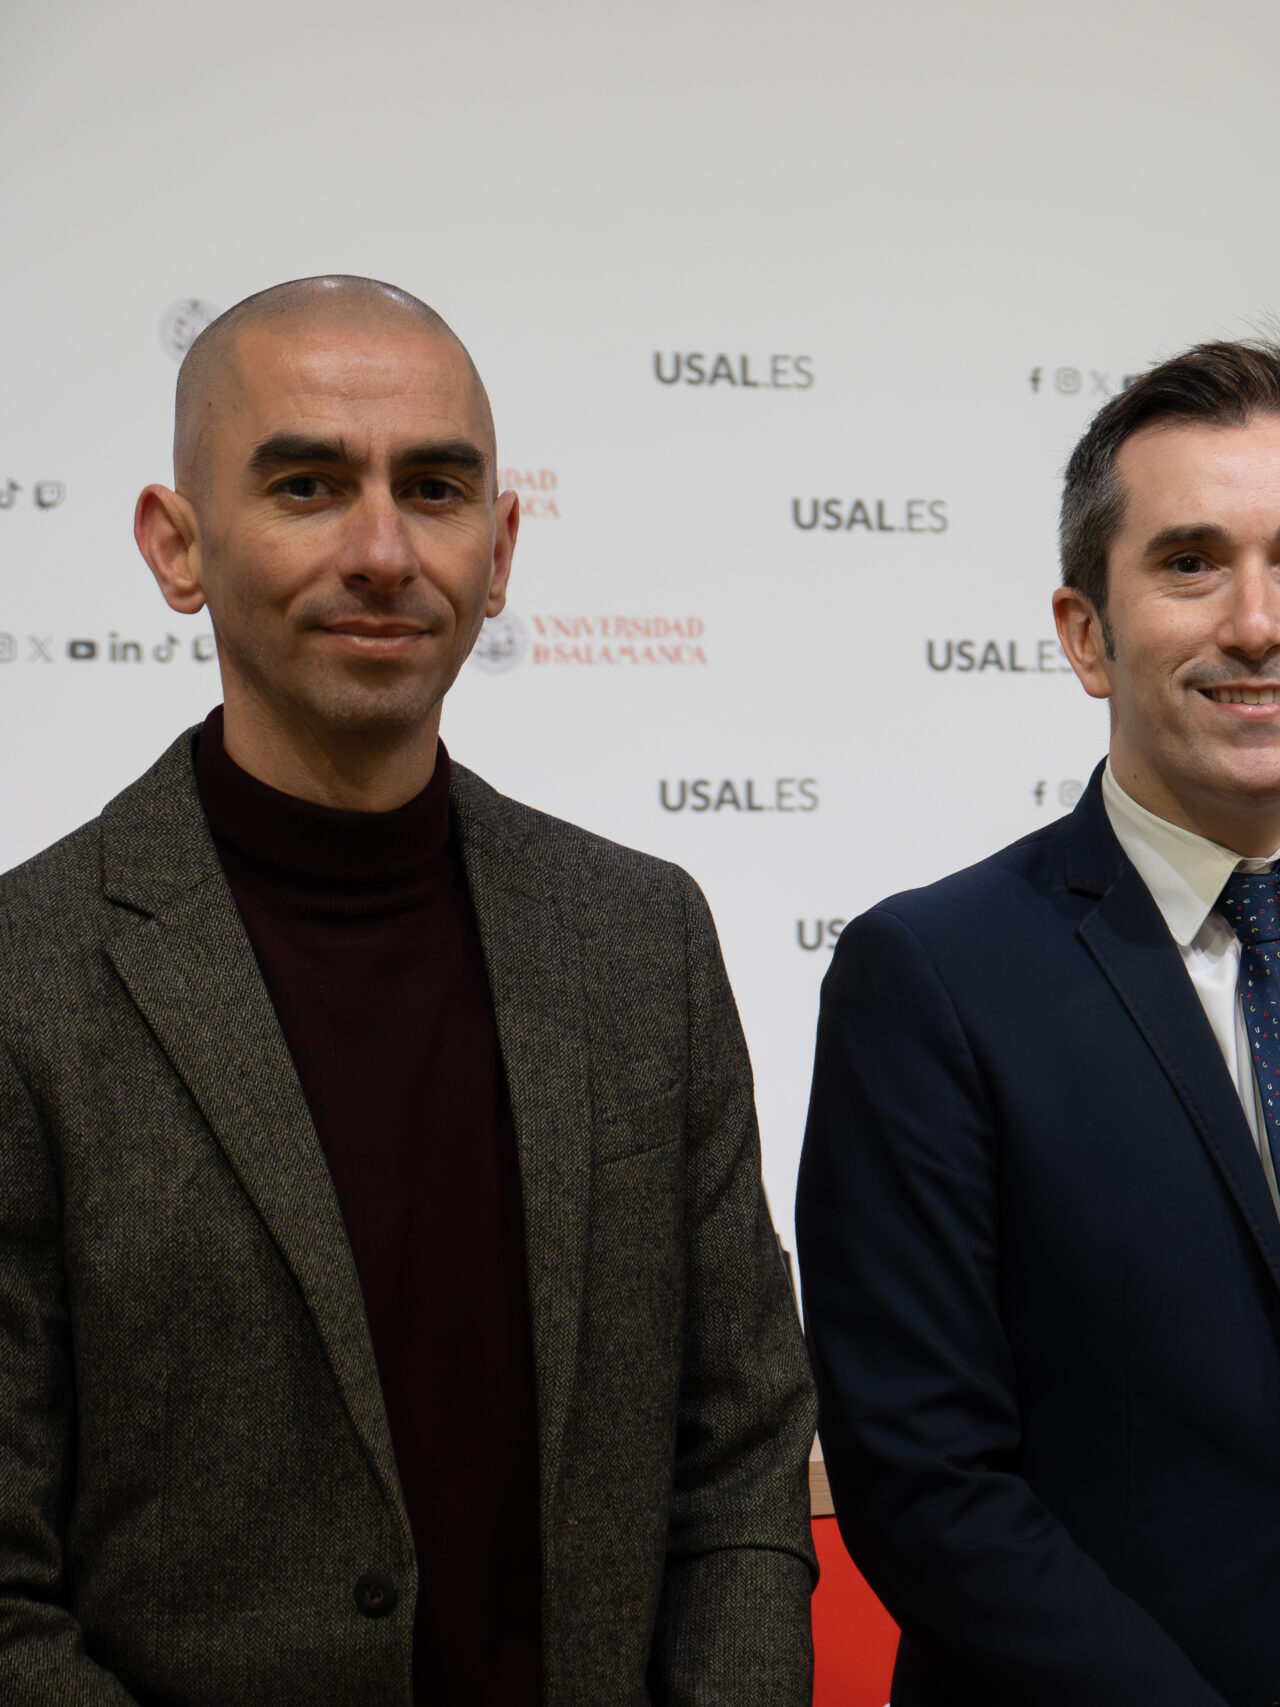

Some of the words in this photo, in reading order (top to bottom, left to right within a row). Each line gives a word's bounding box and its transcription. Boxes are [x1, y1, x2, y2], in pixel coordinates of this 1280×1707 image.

[653, 351, 814, 389] USAL.ES
[791, 497, 948, 533] USAL.ES
[659, 778, 819, 813] USAL.ES
